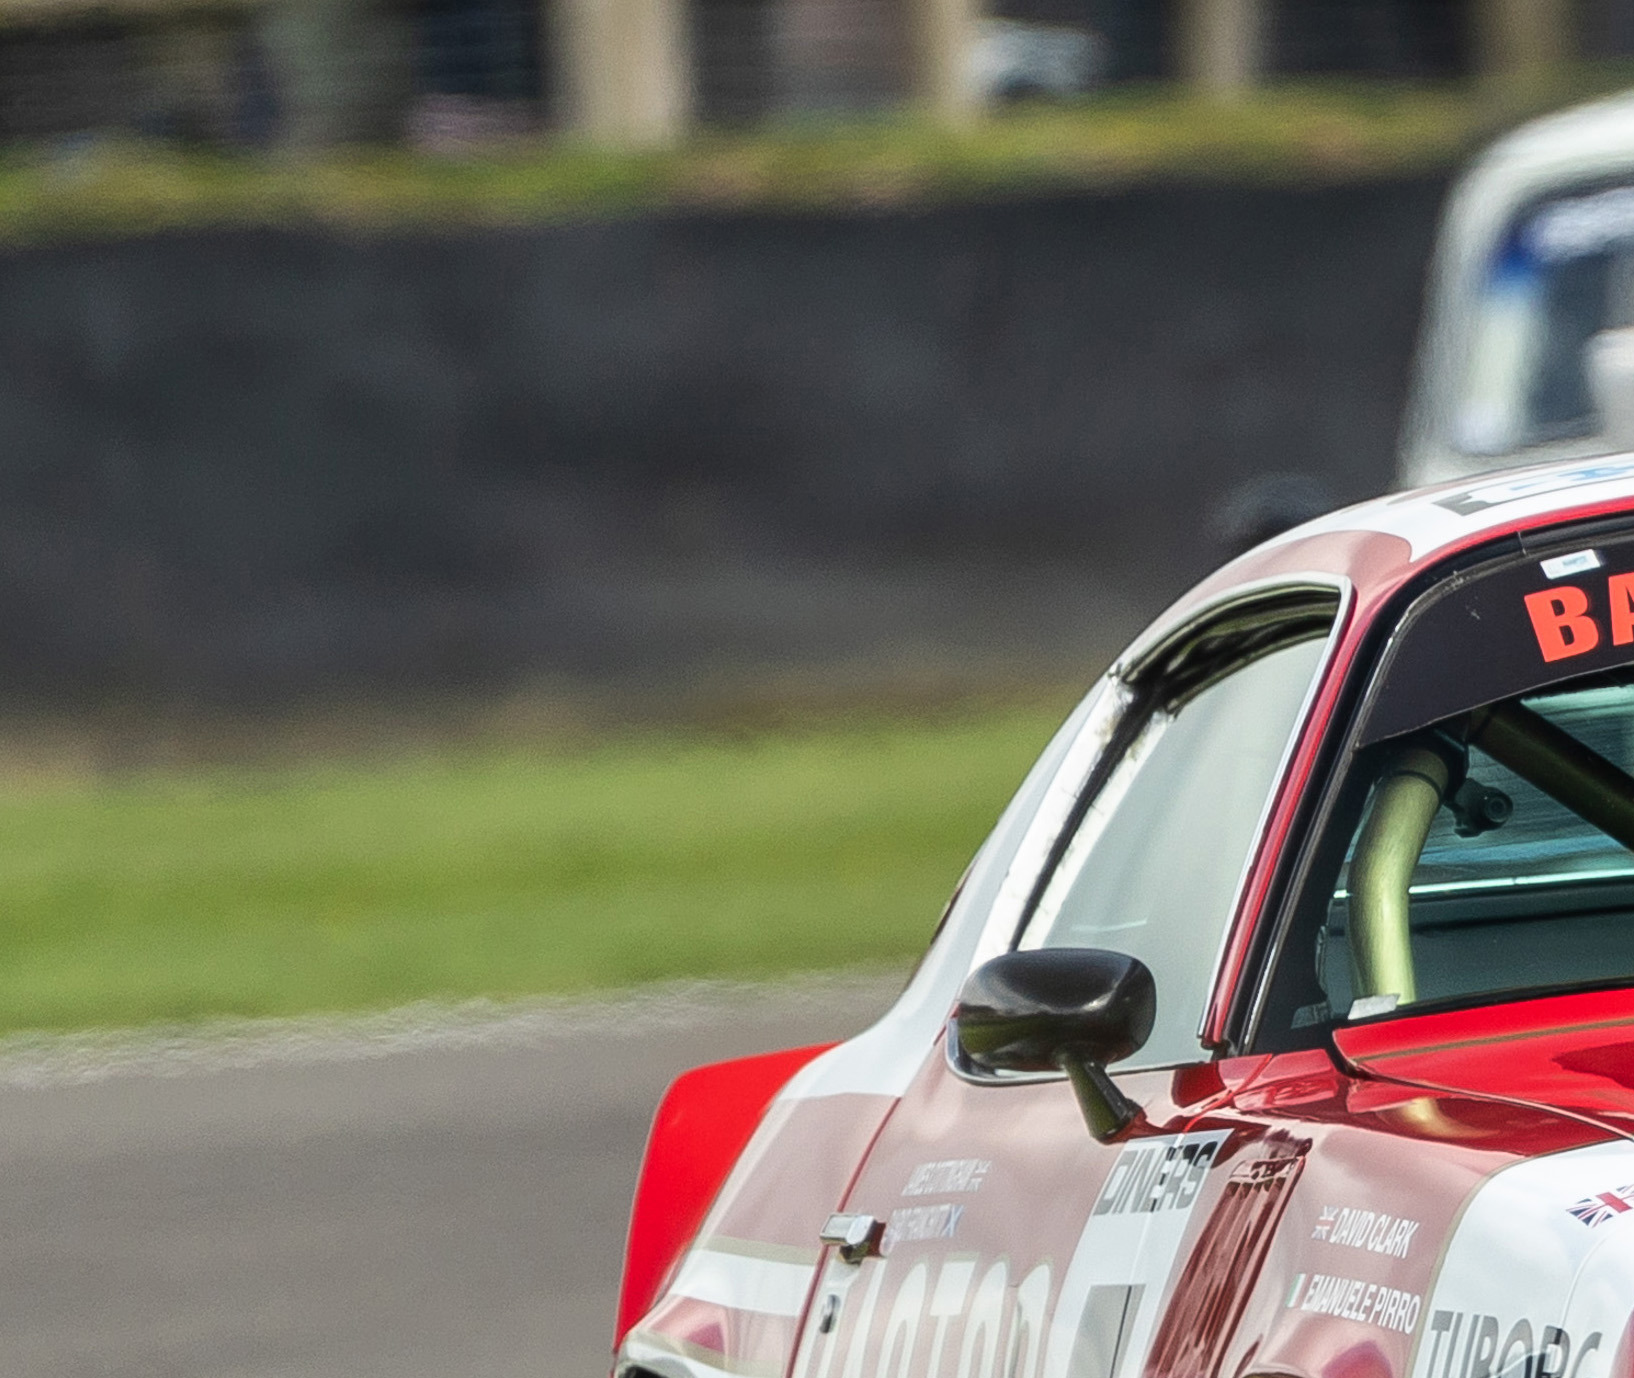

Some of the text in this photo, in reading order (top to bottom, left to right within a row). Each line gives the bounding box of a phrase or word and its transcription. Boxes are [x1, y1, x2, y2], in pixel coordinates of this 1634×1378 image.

[1093, 1141, 1218, 1216] DINERS
[1329, 1207, 1420, 1259] DAVID CLARK
[1300, 1274, 1421, 1334] EMANUELE PIRRO
